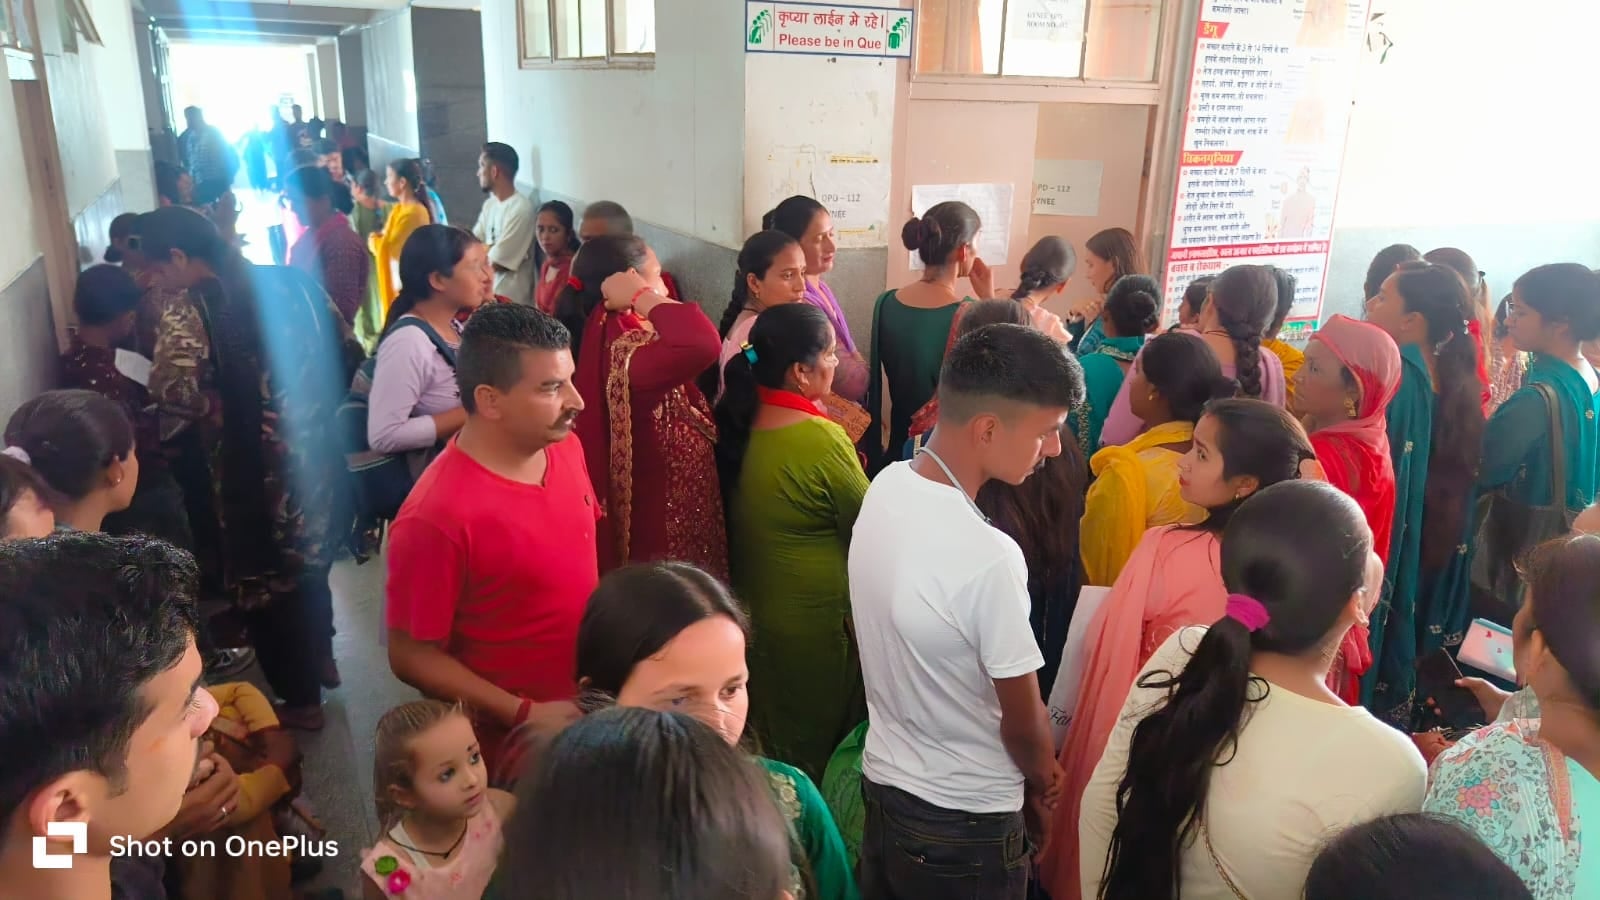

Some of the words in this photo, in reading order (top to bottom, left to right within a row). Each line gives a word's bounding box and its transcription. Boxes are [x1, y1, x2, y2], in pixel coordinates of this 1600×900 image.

[777, 11, 810, 28] कृप्या
[813, 10, 845, 27] लाईन
[848, 11, 860, 27] मे
[864, 12, 884, 29] रहे।
[779, 34, 821, 46] Please
[825, 36, 840, 48] be
[844, 36, 854, 48] in
[858, 37, 881, 50] Que
[1037, 183, 1048, 192] PD
[1057, 184, 1071, 192] 112
[847, 193, 861, 202] 112
[830, 210, 846, 218] NEE
